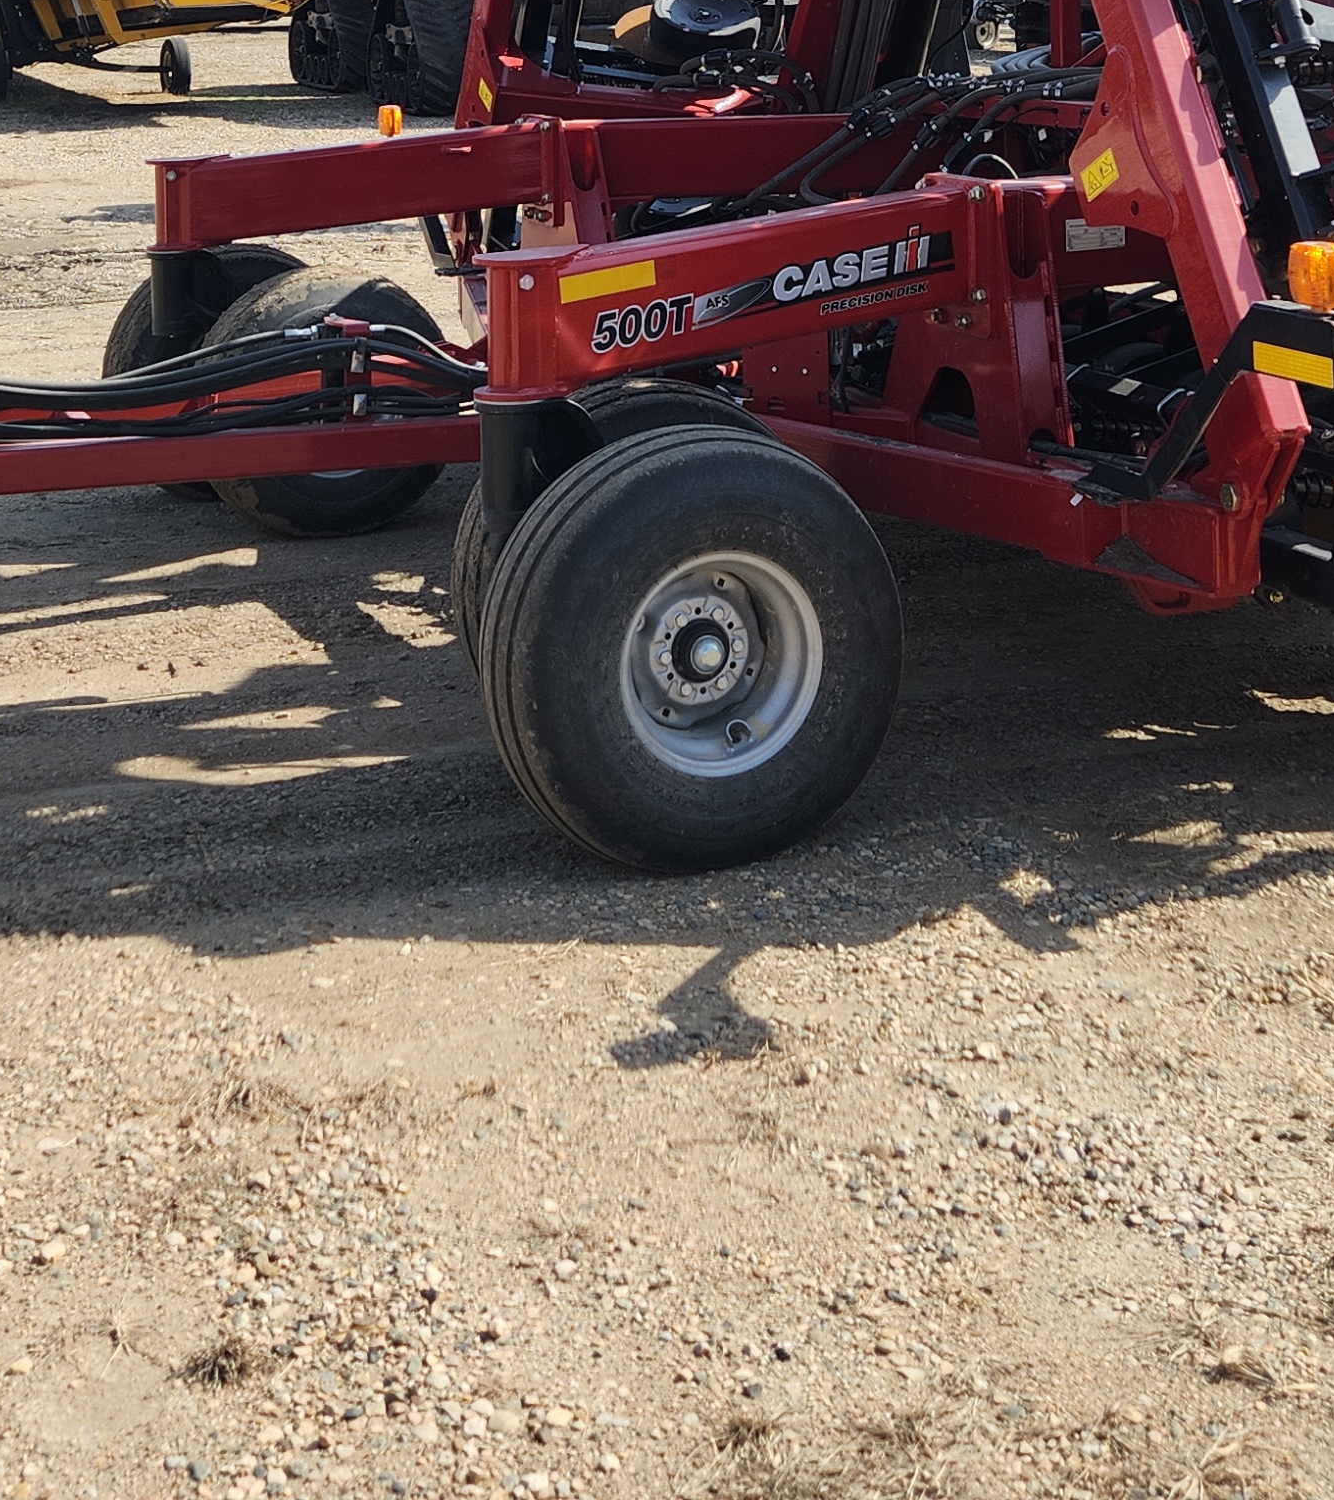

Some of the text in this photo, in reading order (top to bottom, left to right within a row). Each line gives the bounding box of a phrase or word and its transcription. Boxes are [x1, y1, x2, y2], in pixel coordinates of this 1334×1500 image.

[772, 245, 889, 302] CASE
[704, 295, 730, 310] AFS
[819, 281, 929, 315] PRECISION DISK
[591, 293, 695, 354] 500T
